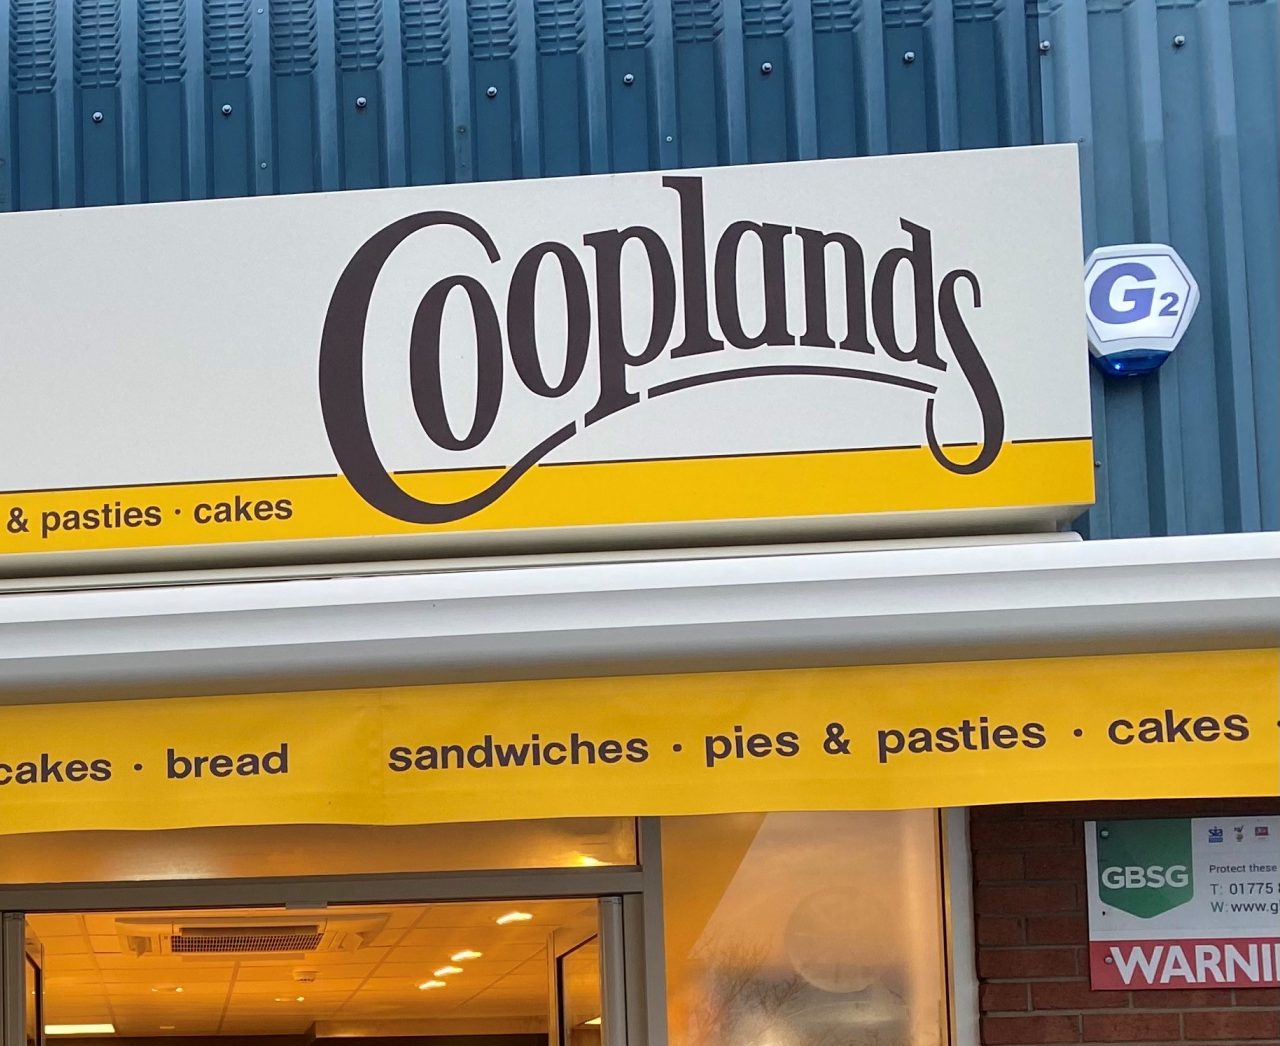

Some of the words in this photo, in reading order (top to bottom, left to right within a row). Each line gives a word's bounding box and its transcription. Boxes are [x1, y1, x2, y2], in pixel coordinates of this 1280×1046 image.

[319, 175, 1005, 524] Cooplands
[7, 508, 29, 534] &
[43, 502, 162, 540] pasties
[194, 496, 293, 525] cakes
[389, 733, 649, 773] sandwiches
[706, 726, 800, 768] pies
[824, 723, 850, 756] &
[878, 717, 1047, 765] pasties
[1109, 710, 1251, 746] cakes
[168, 744, 289, 780] bread
[1101, 865, 1189, 890] GBSG
[1209, 864, 1246, 873] Protect
[1249, 864, 1278, 873] these
[1229, 882, 1274, 895] 01775
[1230, 902, 1280, 915] www.g
[1109, 943, 1280, 985] WARNI
